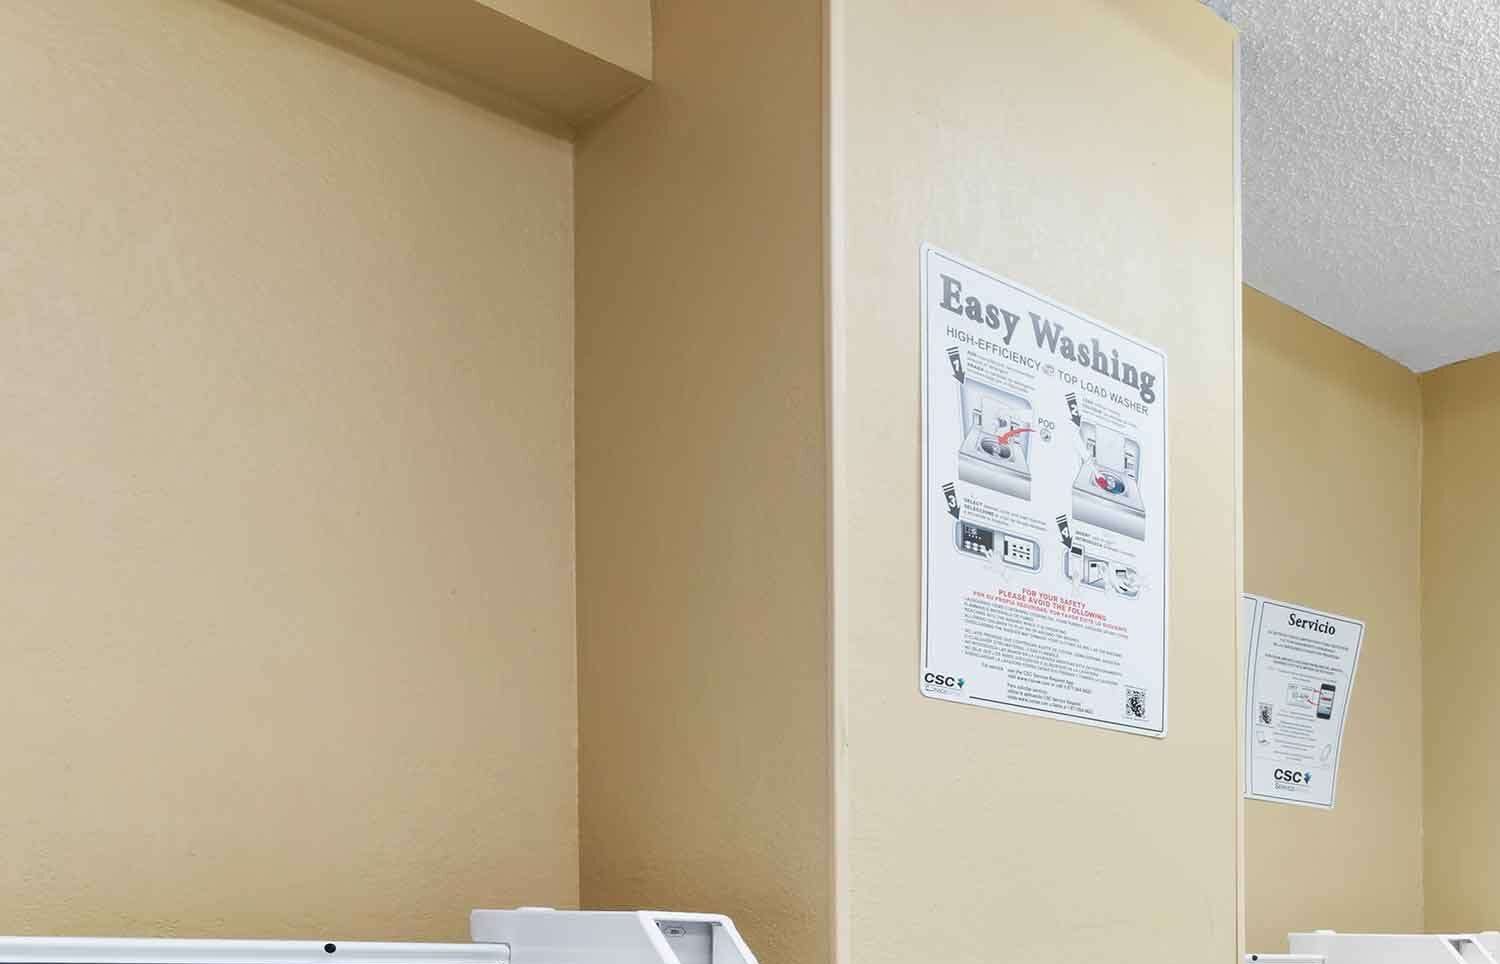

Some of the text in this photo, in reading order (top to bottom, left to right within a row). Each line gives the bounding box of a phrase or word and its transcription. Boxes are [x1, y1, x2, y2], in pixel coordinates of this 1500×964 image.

[940, 273, 1020, 345] Easy
[1028, 311, 1156, 404] Washing
[946, 326, 1041, 371] HIGH-EFFICIENCY
[1058, 369, 1078, 385] TOP
[1080, 379, 1107, 399] LOAD
[1109, 391, 1149, 416] WASHER
[998, 589, 1026, 601] PLEASE
[1288, 613, 1336, 636] Servicio
[924, 672, 955, 688] CSC
[1273, 768, 1303, 784] CSC
